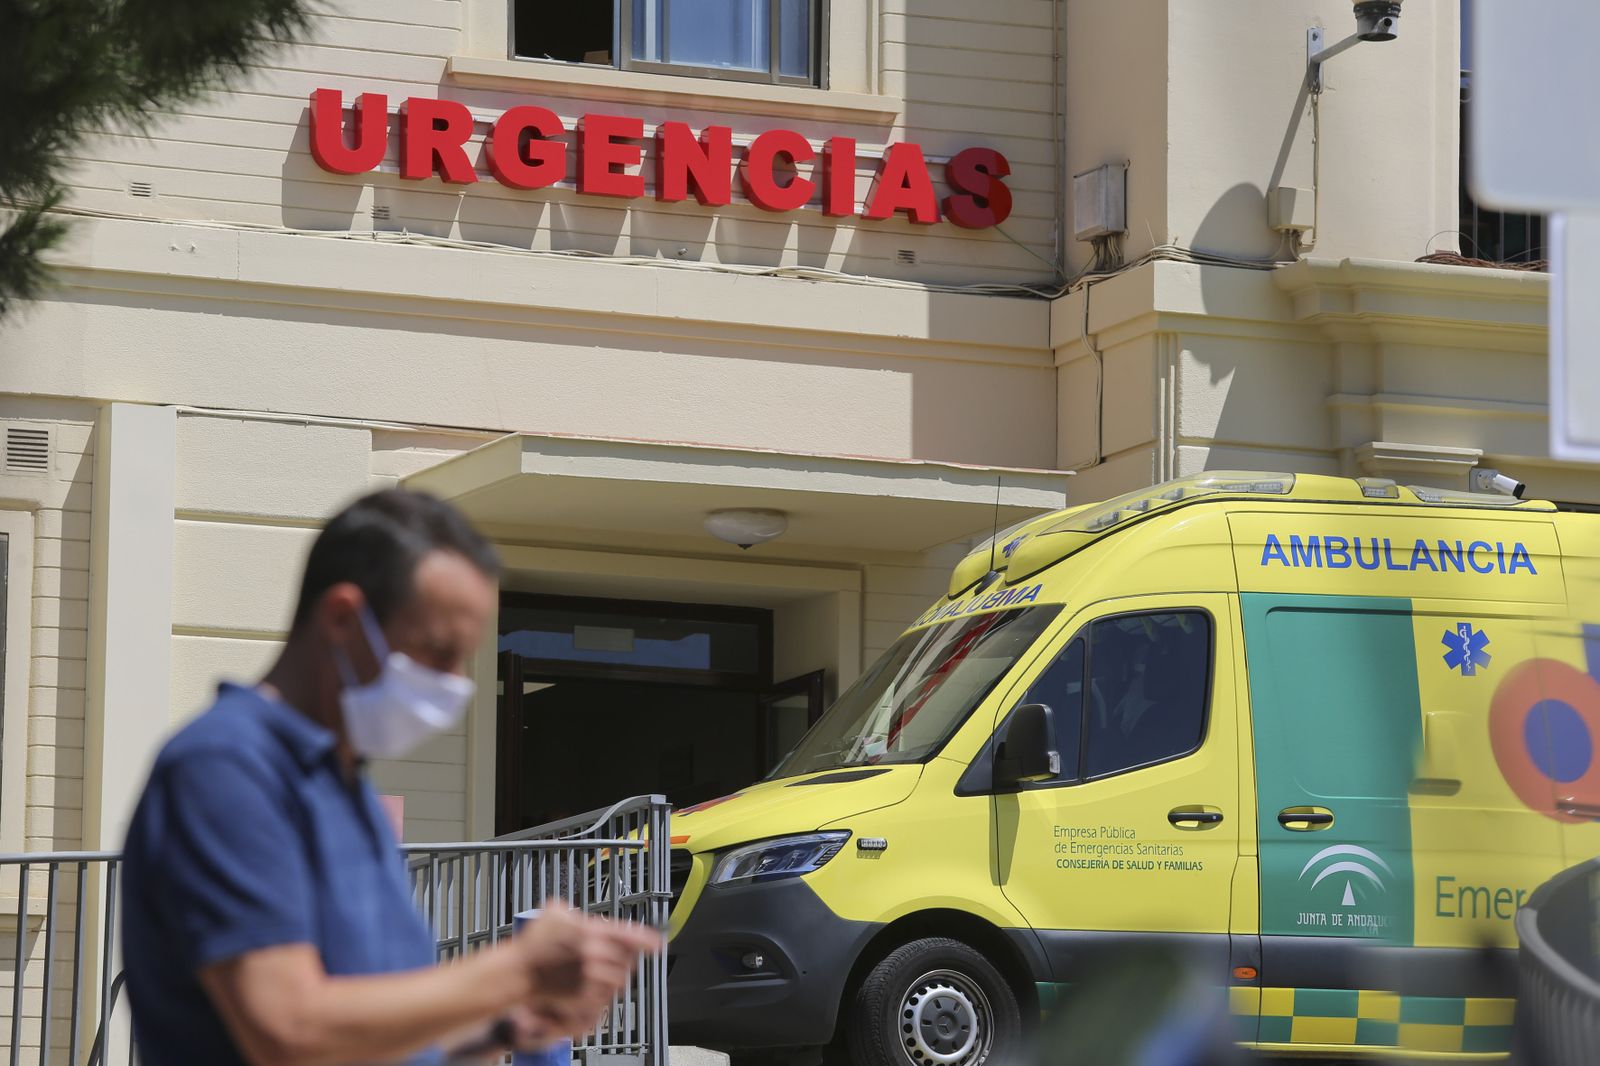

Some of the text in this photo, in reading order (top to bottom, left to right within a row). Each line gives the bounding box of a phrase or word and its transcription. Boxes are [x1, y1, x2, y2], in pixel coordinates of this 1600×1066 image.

[309, 87, 1013, 230] URGENCIAS
[1260, 534, 1538, 576] AMBULANCIA
[1053, 825, 1136, 841] Empresa Pública
[1054, 842, 1184, 858] de Emergencias Sanitarias
[1112, 860, 1124, 870] DE
[1126, 860, 1154, 870] SALUD
[1157, 861, 1162, 870] Y
[1164, 861, 1203, 871] FAMILIAS
[1297, 912, 1327, 926] JUNTA
[1331, 913, 1343, 926] DE
